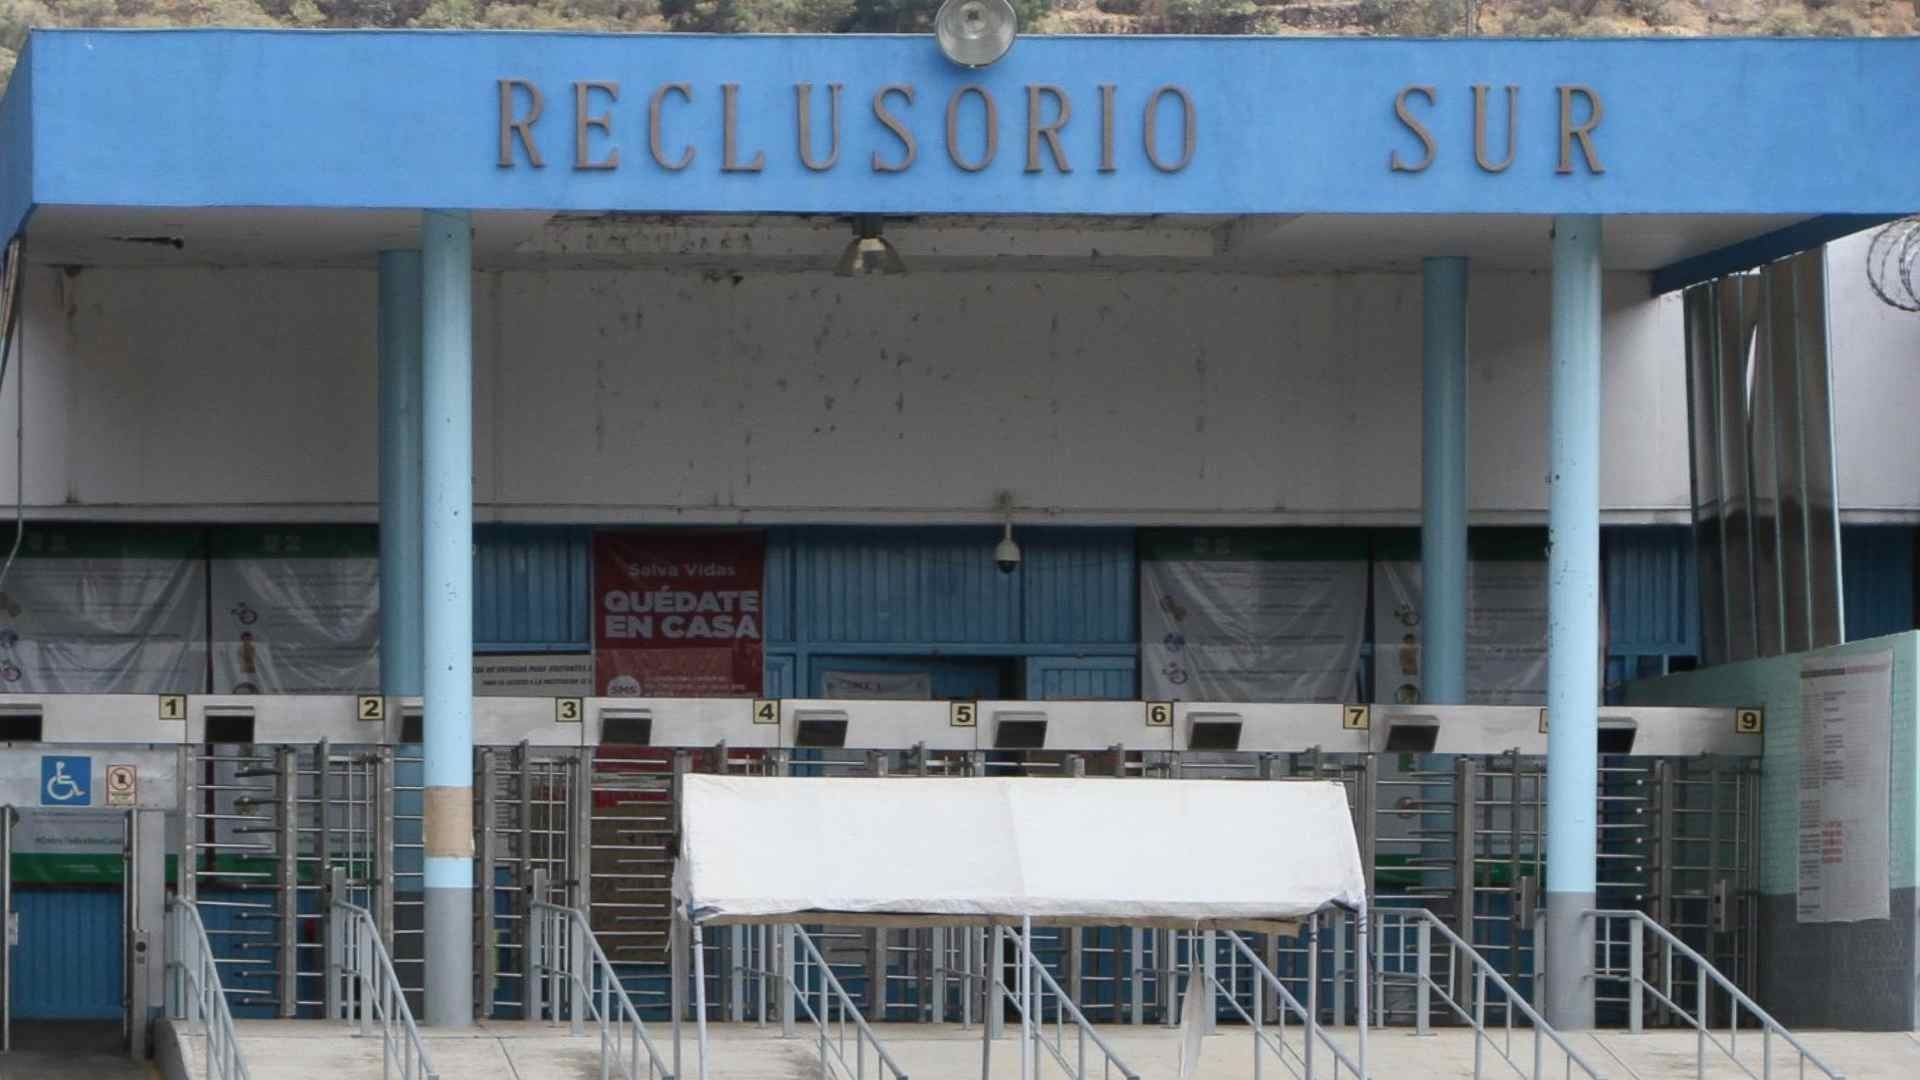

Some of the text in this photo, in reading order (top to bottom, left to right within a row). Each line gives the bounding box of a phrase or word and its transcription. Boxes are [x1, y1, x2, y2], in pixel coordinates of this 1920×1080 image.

[496, 79, 1606, 175] RECLUSORIO SUR
[628, 562, 737, 577] Salva Vidas
[604, 585, 759, 613] QUÉDATE
[605, 614, 760, 639] EN CASA
[165, 699, 177, 716] 1
[364, 699, 380, 717] 2
[562, 701, 577, 719] 3
[758, 703, 775, 721] 4
[956, 705, 971, 723] 5
[1151, 705, 1167, 723] 6
[1350, 708, 1365, 726] 7
[1742, 712, 1758, 730] 9
